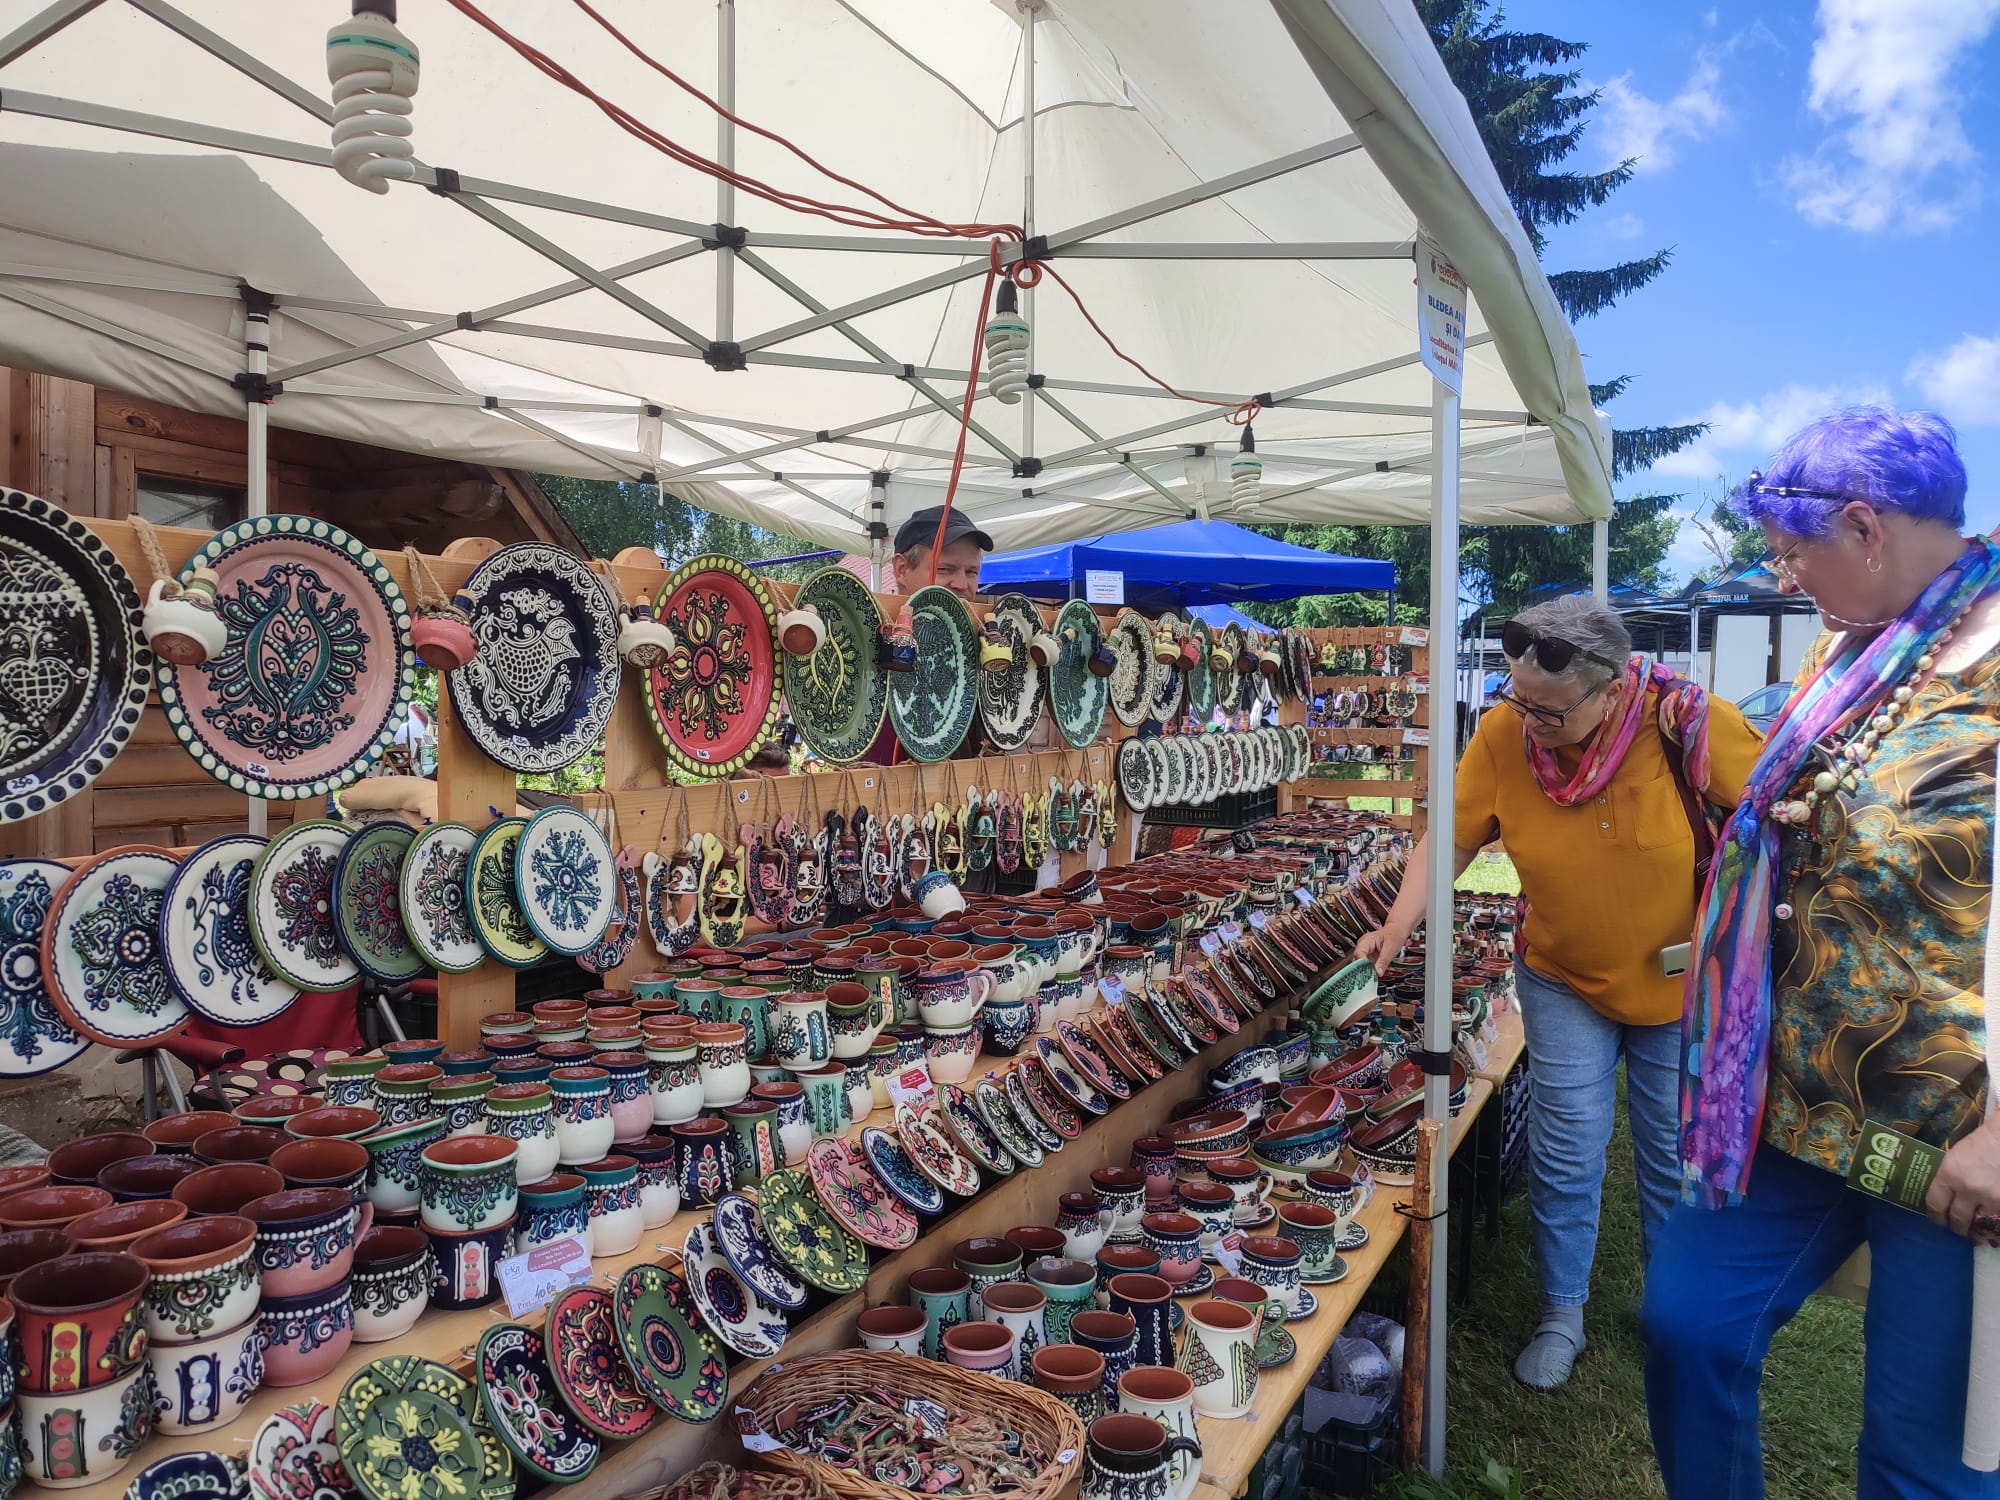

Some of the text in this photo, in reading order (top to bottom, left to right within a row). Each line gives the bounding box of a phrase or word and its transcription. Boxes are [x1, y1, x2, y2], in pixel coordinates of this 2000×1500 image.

[1428, 294, 1453, 319] BLEDEA
[249, 763, 266, 774] 250
[11, 777, 34, 790] 250
[535, 1283, 547, 1299] 40
